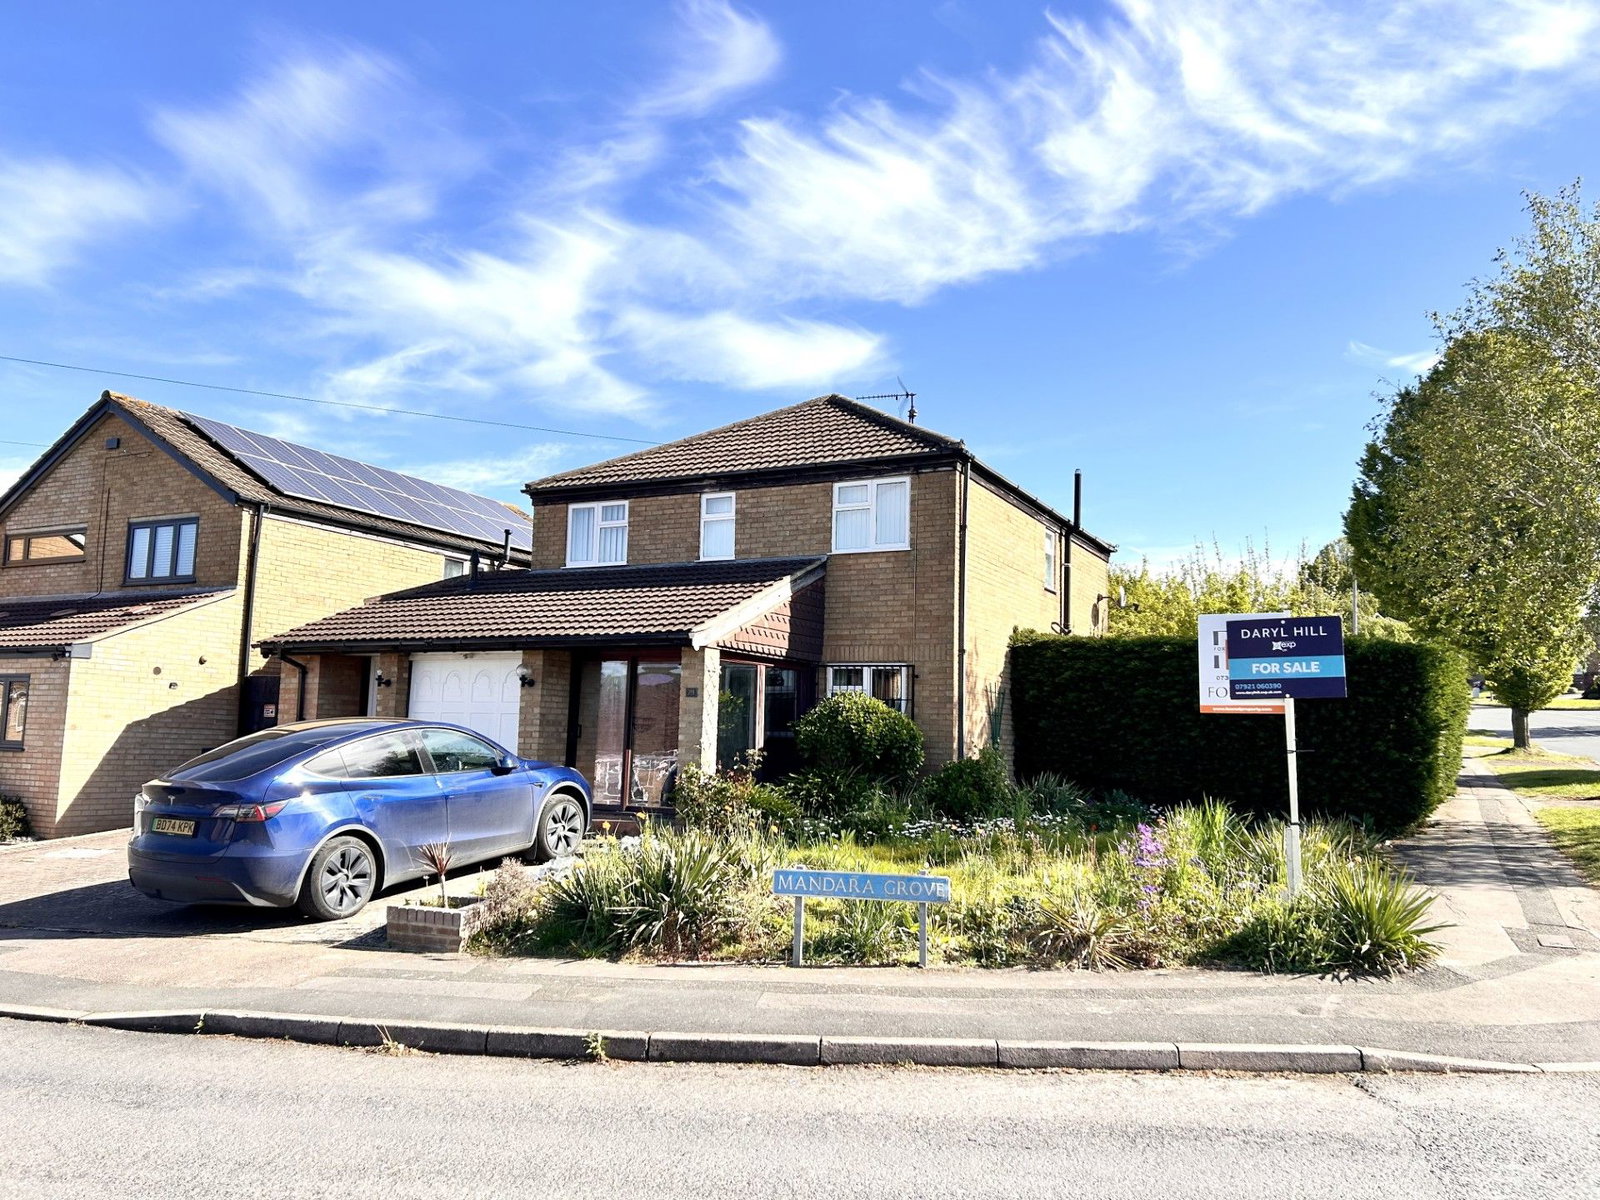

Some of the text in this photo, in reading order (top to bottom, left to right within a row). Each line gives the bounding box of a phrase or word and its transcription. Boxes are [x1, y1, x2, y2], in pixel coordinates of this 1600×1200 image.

[1241, 626, 1327, 639] DARYL HILL
[1252, 662, 1320, 674] FOR SALE
[156, 820, 194, 833] BD74 KPK
[778, 874, 946, 898] MANDARA GROVE
